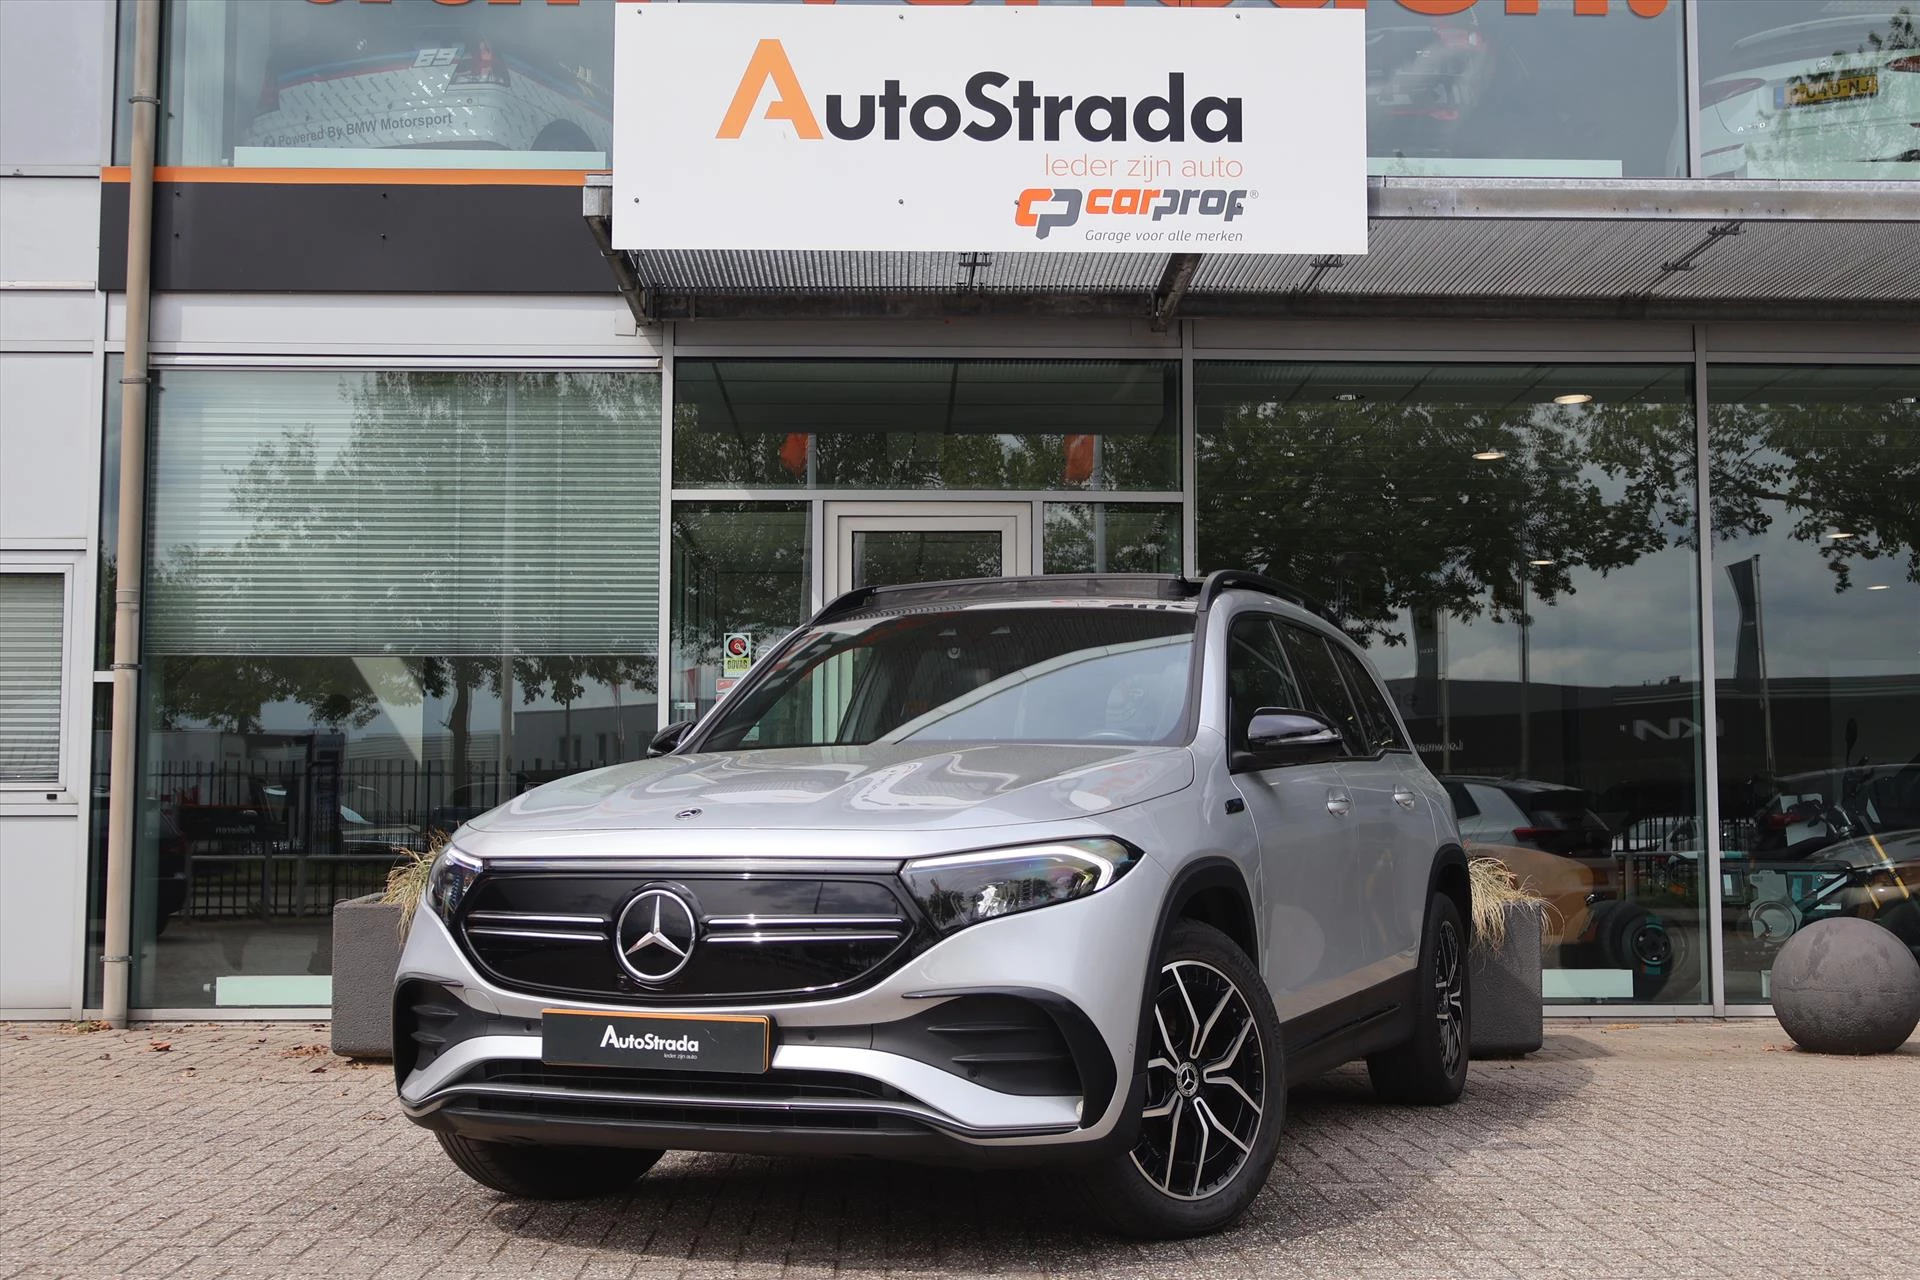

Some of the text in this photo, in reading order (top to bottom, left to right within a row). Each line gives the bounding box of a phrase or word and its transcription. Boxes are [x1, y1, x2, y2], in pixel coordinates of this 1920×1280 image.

[413, 48, 458, 67] 69
[716, 39, 1243, 143] AutoStrada
[278, 112, 453, 146] Powered By BMW Motorsport
[1046, 154, 1243, 183] Ieder zijn auto
[1085, 229, 1243, 244] Garage voor alle merken
[600, 1025, 699, 1052] AutoStrada
